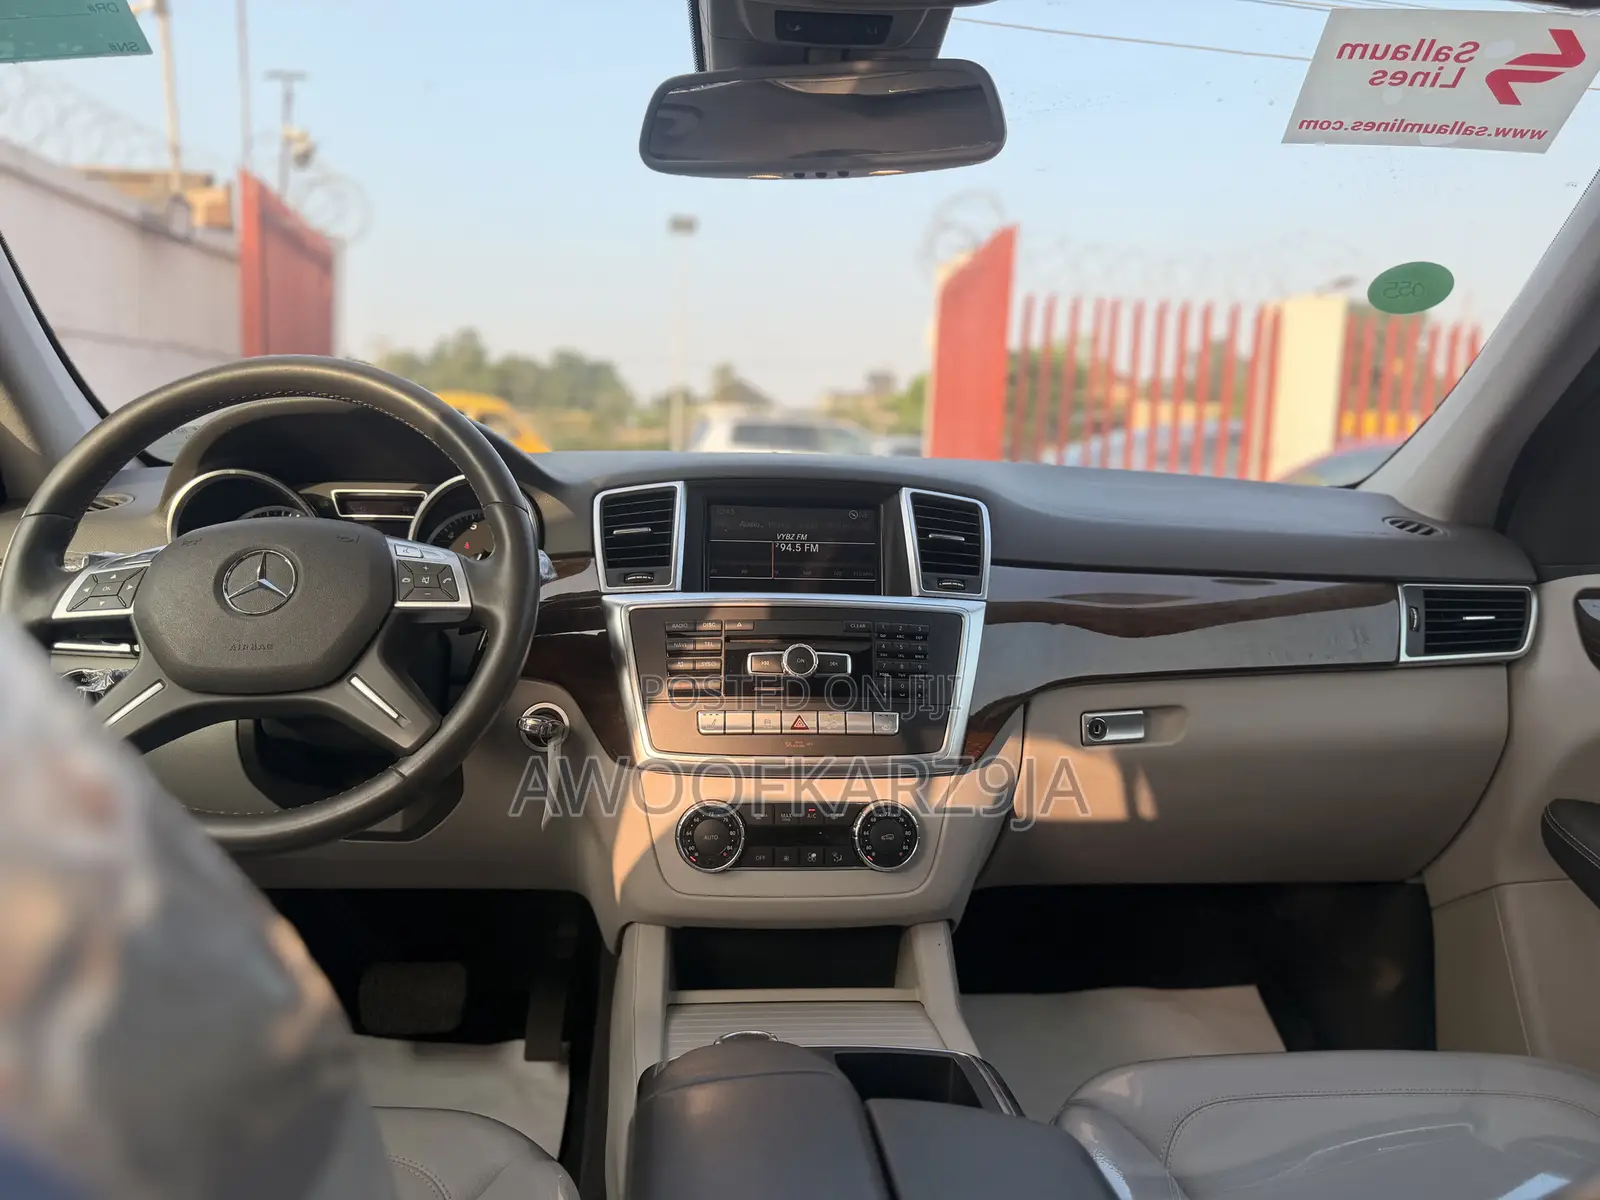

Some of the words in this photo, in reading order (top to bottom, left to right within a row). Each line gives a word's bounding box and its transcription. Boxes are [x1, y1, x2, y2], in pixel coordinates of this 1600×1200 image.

[776, 533, 795, 541] VYBZ
[780, 543, 802, 553] 94.5
[804, 544, 819, 553] FM
